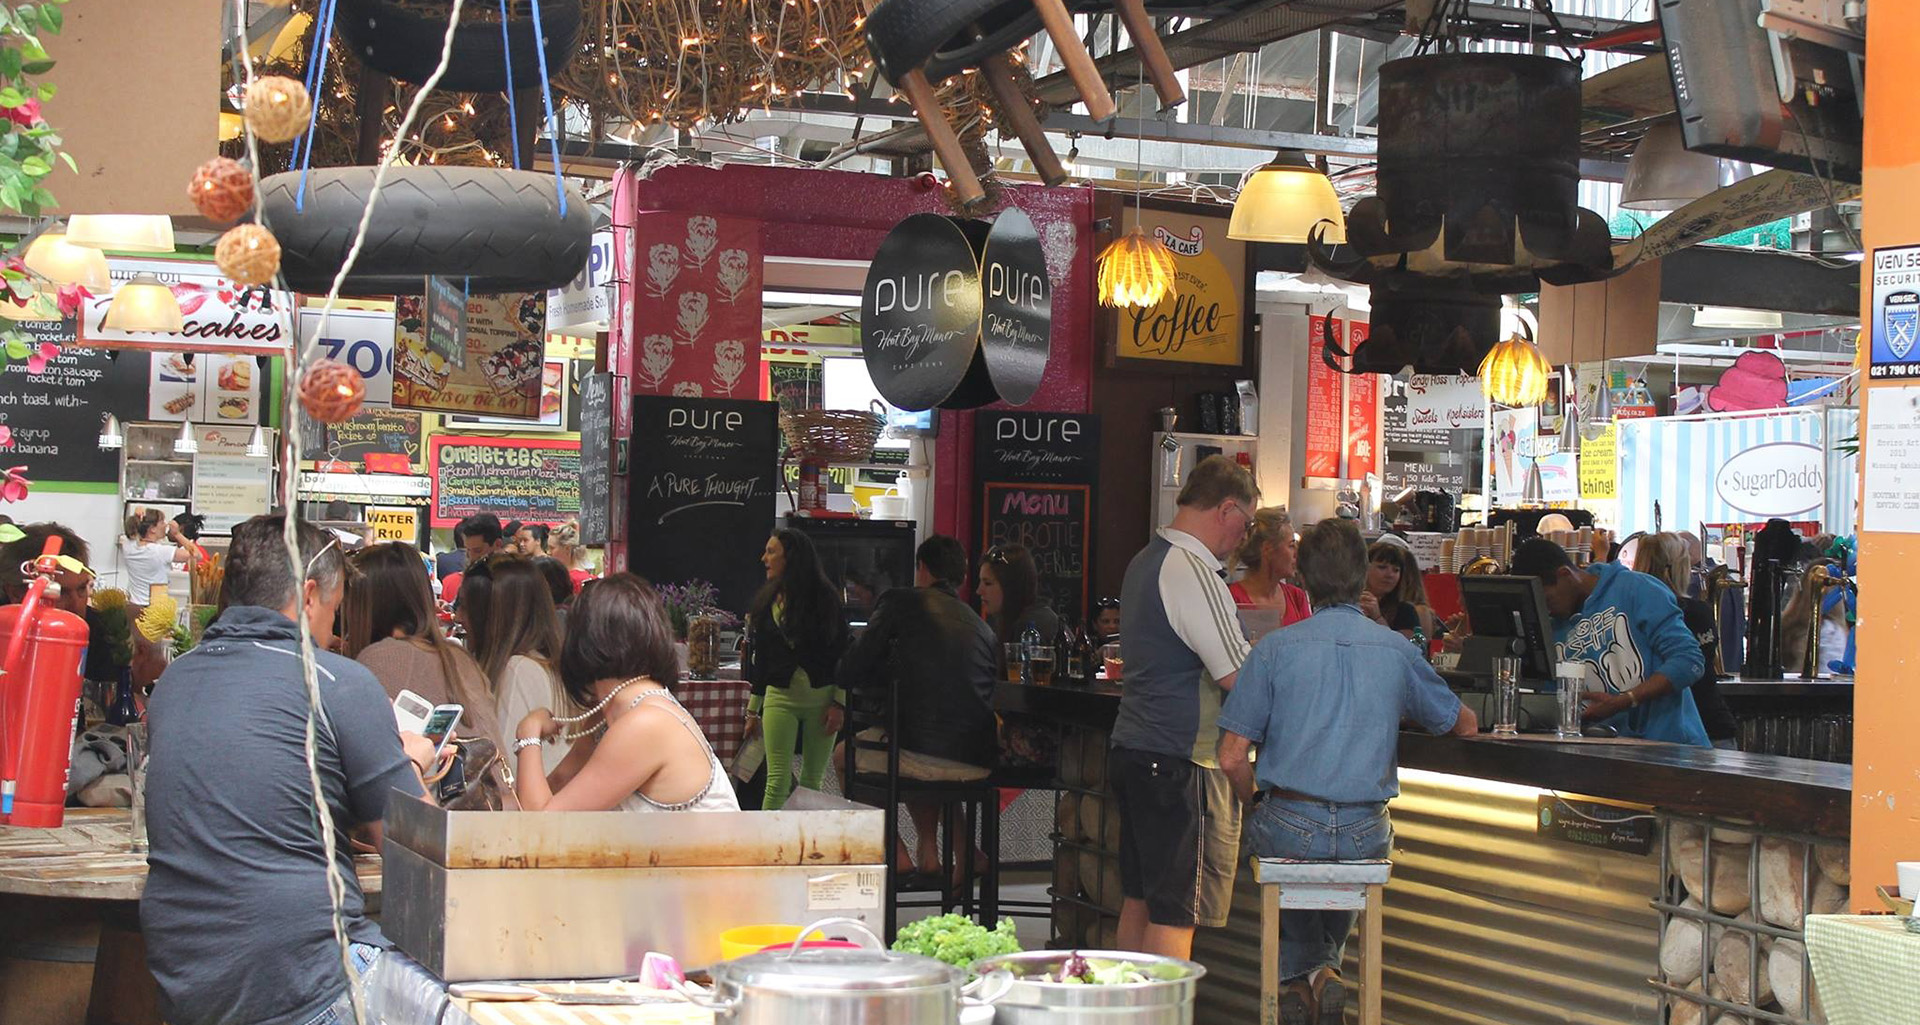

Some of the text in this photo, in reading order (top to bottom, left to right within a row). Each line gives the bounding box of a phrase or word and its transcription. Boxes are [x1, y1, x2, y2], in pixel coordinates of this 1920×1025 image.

[876, 269, 965, 316] pure
[989, 262, 1043, 310] pure
[25, 320, 62, 331] tomato
[1128, 295, 1236, 354] Coffee
[318, 338, 392, 379] ZO
[27, 373, 55, 384] rocket
[65, 374, 86, 386] tom
[63, 365, 104, 383] sausage
[1871, 366, 1886, 377] 021
[1888, 367, 1906, 377] 790
[22, 392, 51, 406] toast
[668, 408, 744, 431] pure
[1412, 408, 1439, 425] Sweets
[20, 429, 50, 442] syrup
[996, 417, 1081, 443] pure
[18, 442, 58, 455] banana
[441, 445, 544, 468] Omelettes
[1403, 463, 1434, 473] MENU
[647, 475, 664, 499] A
[664, 472, 701, 498] PURE
[1582, 478, 1614, 494] thing!
[1002, 491, 1069, 516] Menu
[367, 512, 414, 526] WATER
[378, 528, 403, 541] R10
